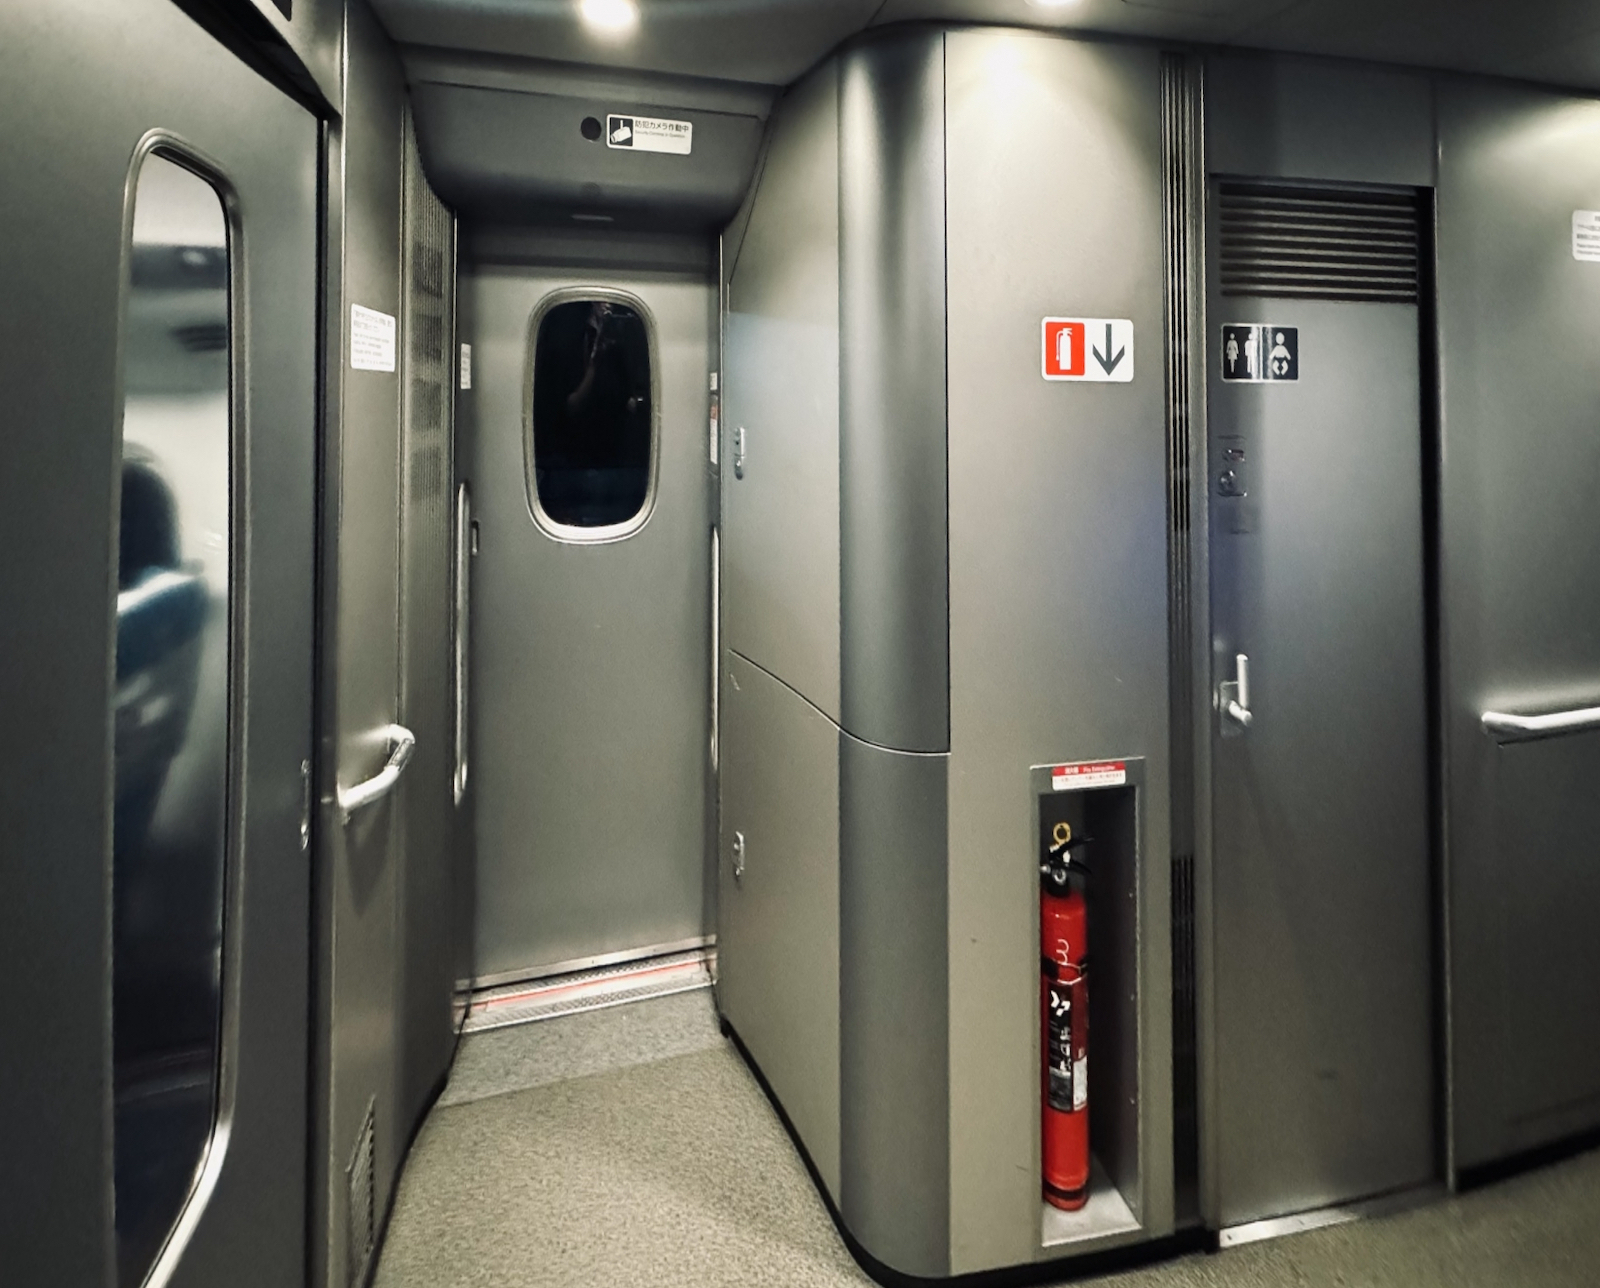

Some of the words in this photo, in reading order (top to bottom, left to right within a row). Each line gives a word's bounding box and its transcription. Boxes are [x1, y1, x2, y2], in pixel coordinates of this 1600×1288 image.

[635, 120, 689, 132] 防犯カメラ作動中
